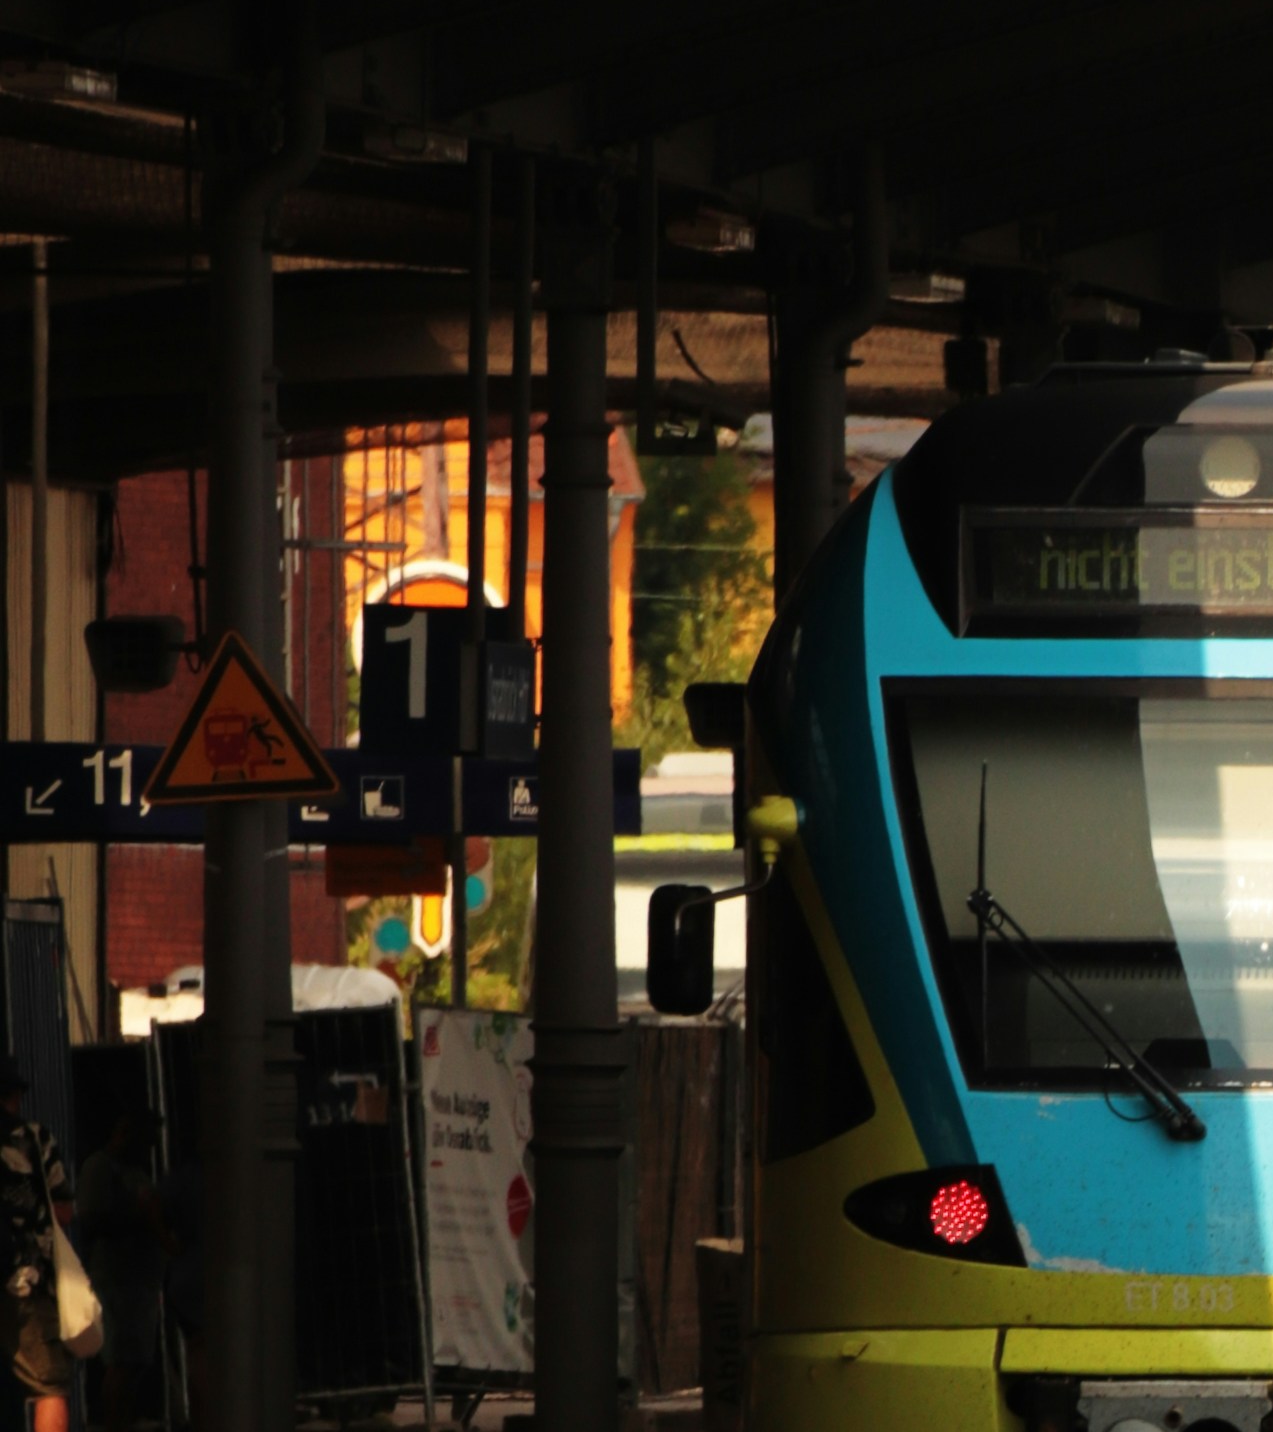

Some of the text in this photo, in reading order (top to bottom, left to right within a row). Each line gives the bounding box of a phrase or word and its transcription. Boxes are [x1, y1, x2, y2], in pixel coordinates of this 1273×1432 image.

[1040, 532, 1149, 591] nicht
[385, 611, 429, 719] 1
[1125, 1281, 1162, 1312] ET
